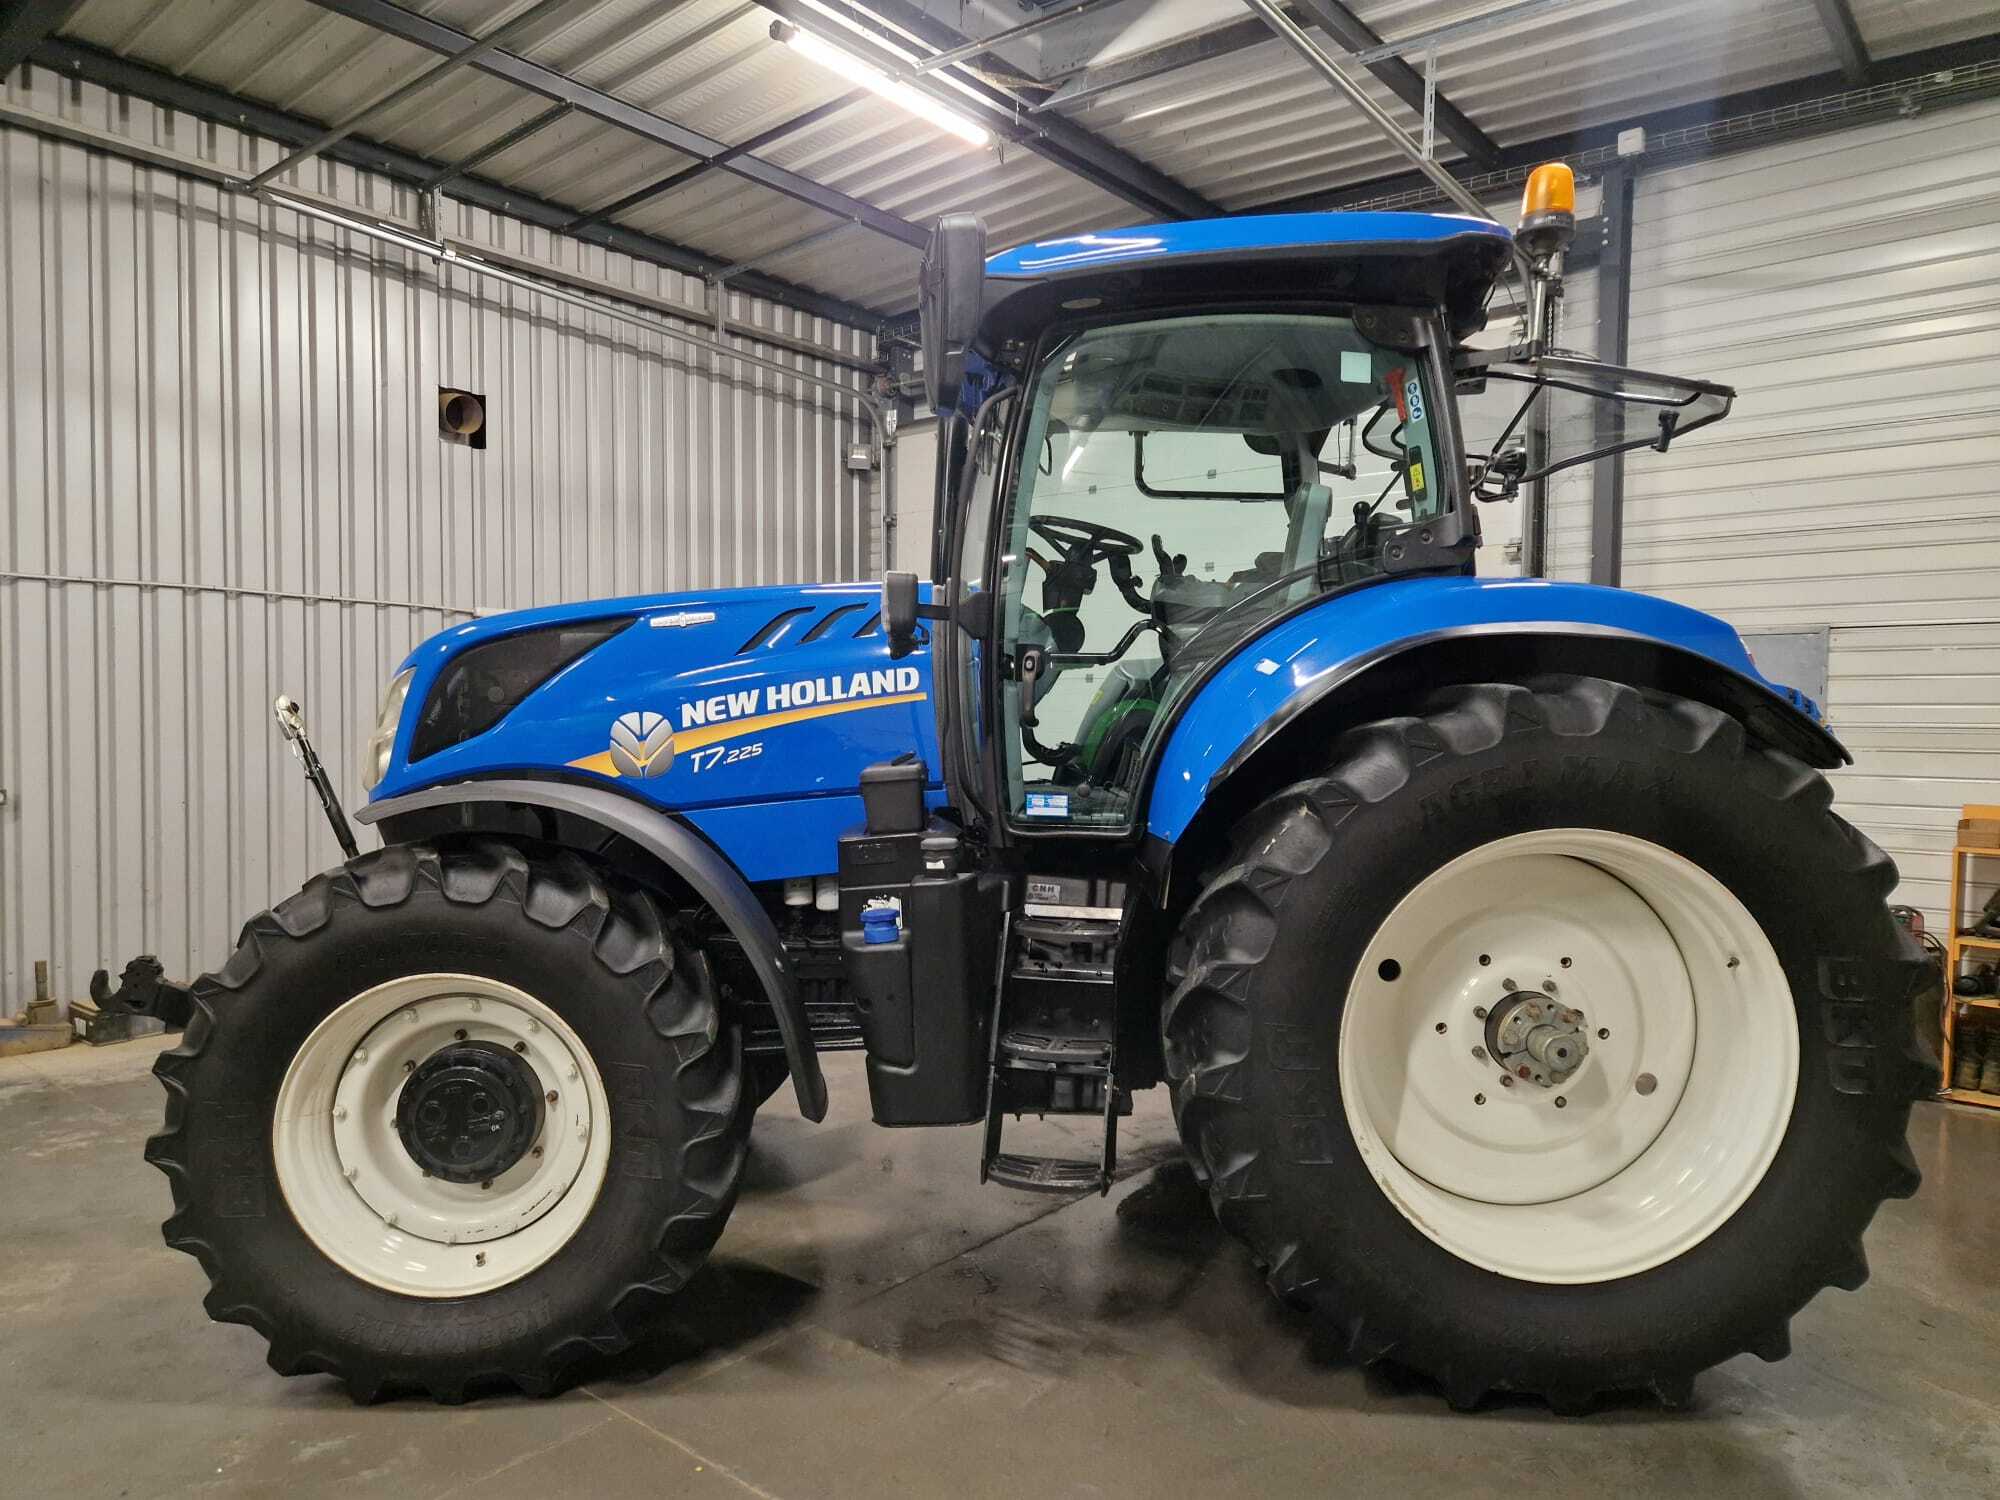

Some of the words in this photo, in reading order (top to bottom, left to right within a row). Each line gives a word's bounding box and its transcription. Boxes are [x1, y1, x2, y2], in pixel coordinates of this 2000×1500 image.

[681, 688, 760, 728] NEW
[766, 667, 920, 711] HOLLAND
[690, 743, 763, 774] T7.225
